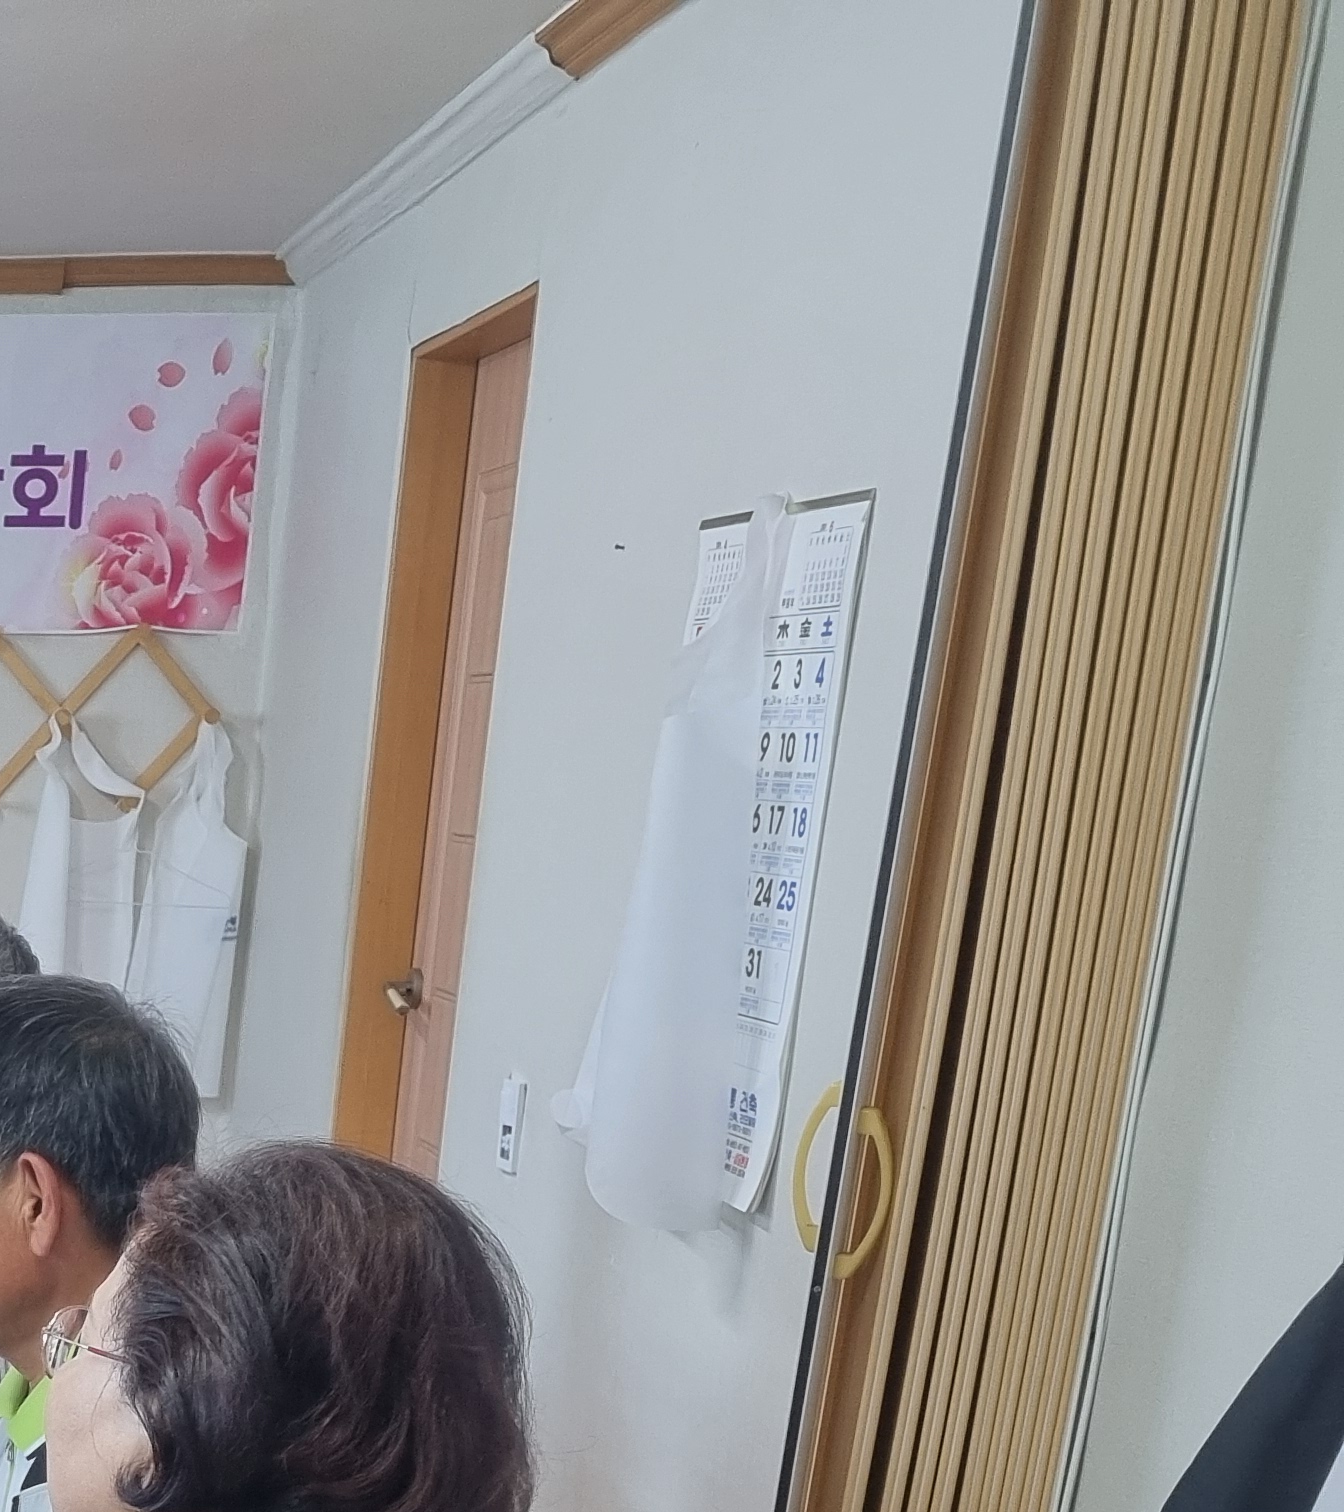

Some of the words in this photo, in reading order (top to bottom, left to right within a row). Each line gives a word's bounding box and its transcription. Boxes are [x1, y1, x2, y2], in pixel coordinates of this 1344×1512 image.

[798, 616, 813, 639] 金
[820, 614, 834, 638] 土
[770, 659, 782, 690] 2
[793, 657, 803, 690] 3
[815, 656, 826, 689] 4
[759, 731, 771, 762] 9
[779, 731, 797, 763] 10
[803, 731, 819, 763] 11
[768, 804, 786, 835] 17
[791, 806, 808, 838] 18
[753, 876, 773, 908] 24
[776, 879, 797, 912] 25
[745, 947, 762, 979] 31
